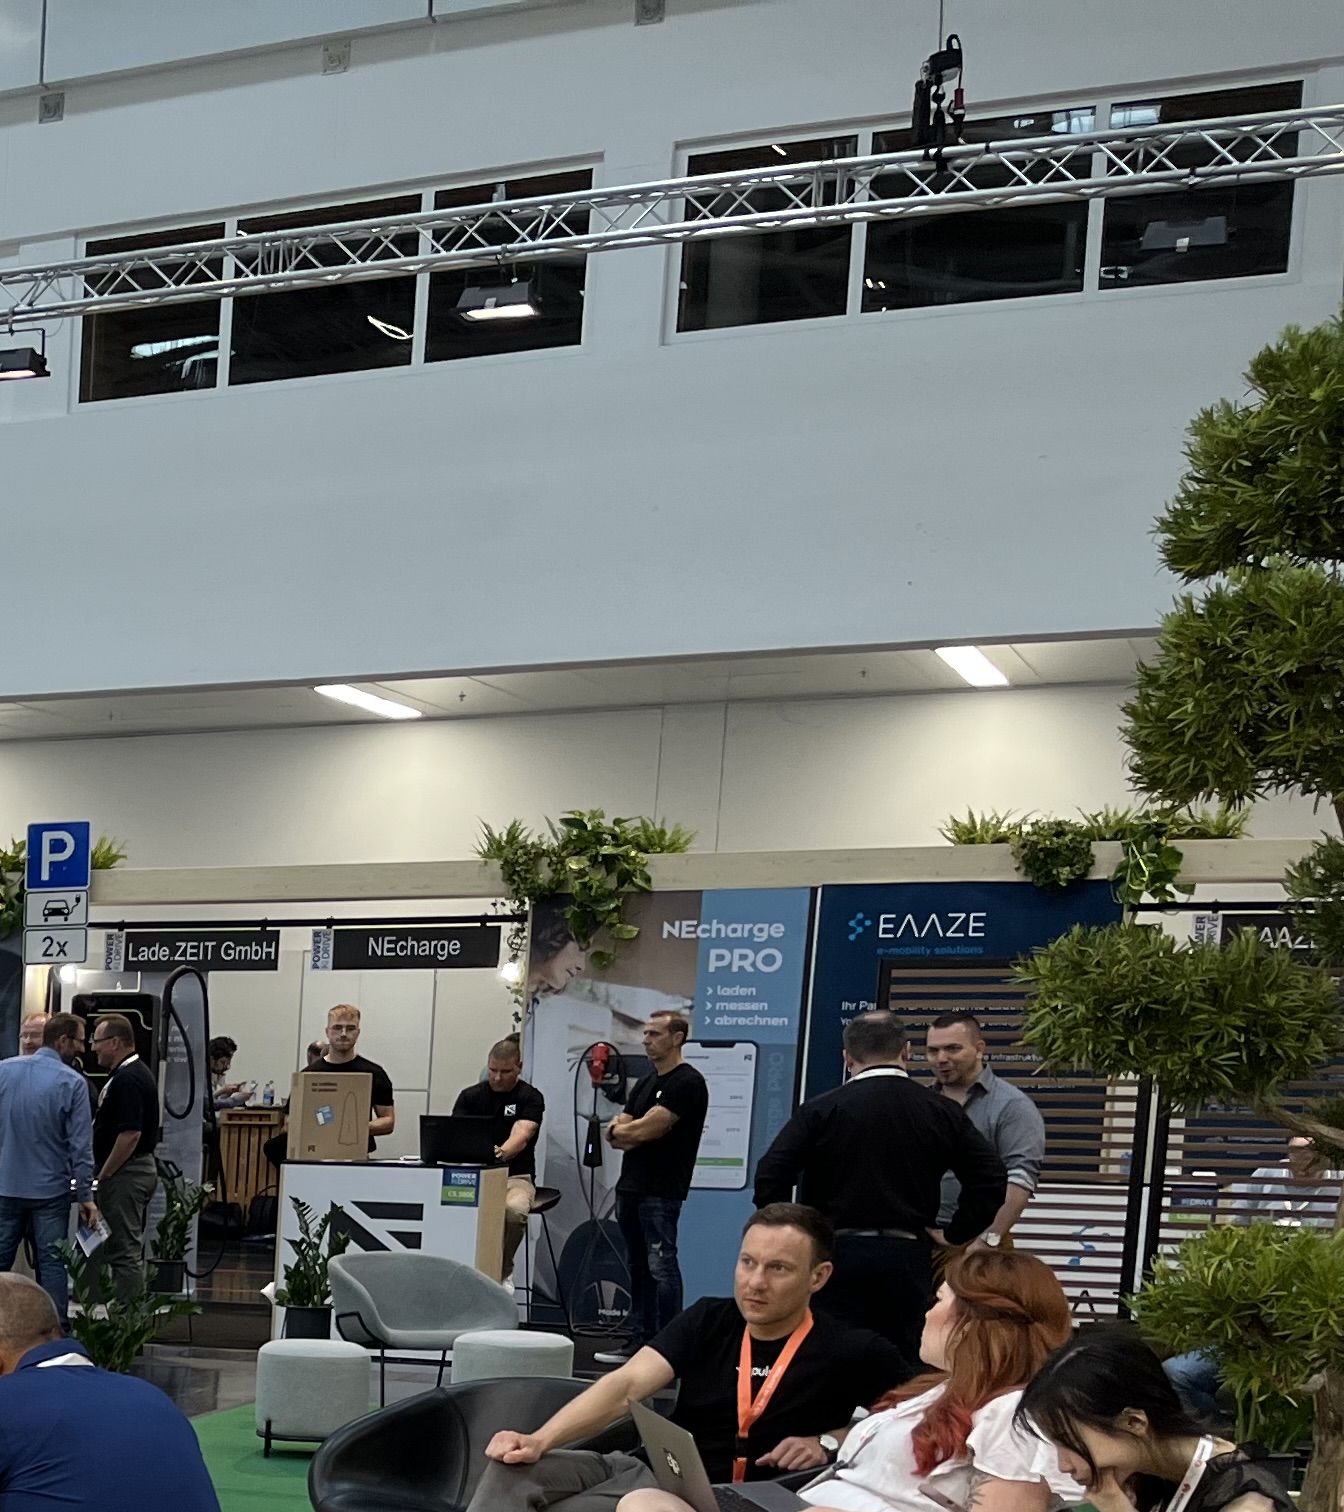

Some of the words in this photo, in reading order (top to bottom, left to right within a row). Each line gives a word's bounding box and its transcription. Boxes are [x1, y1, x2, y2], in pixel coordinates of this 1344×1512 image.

[41, 830, 75, 882] P
[662, 919, 785, 942] NEcharge
[41, 936, 69, 957] 2x
[128, 941, 216, 962] Lade.ZEIT
[220, 940, 275, 961] GmbH
[312, 930, 322, 970] POWER
[367, 936, 461, 961] NEcharge
[934, 945, 983, 955] solutions
[708, 948, 783, 973] PRO
[717, 985, 756, 996] laden
[715, 1001, 768, 1011] messen
[841, 1001, 857, 1011] Ihr
[714, 1015, 788, 1026] abrechnen
